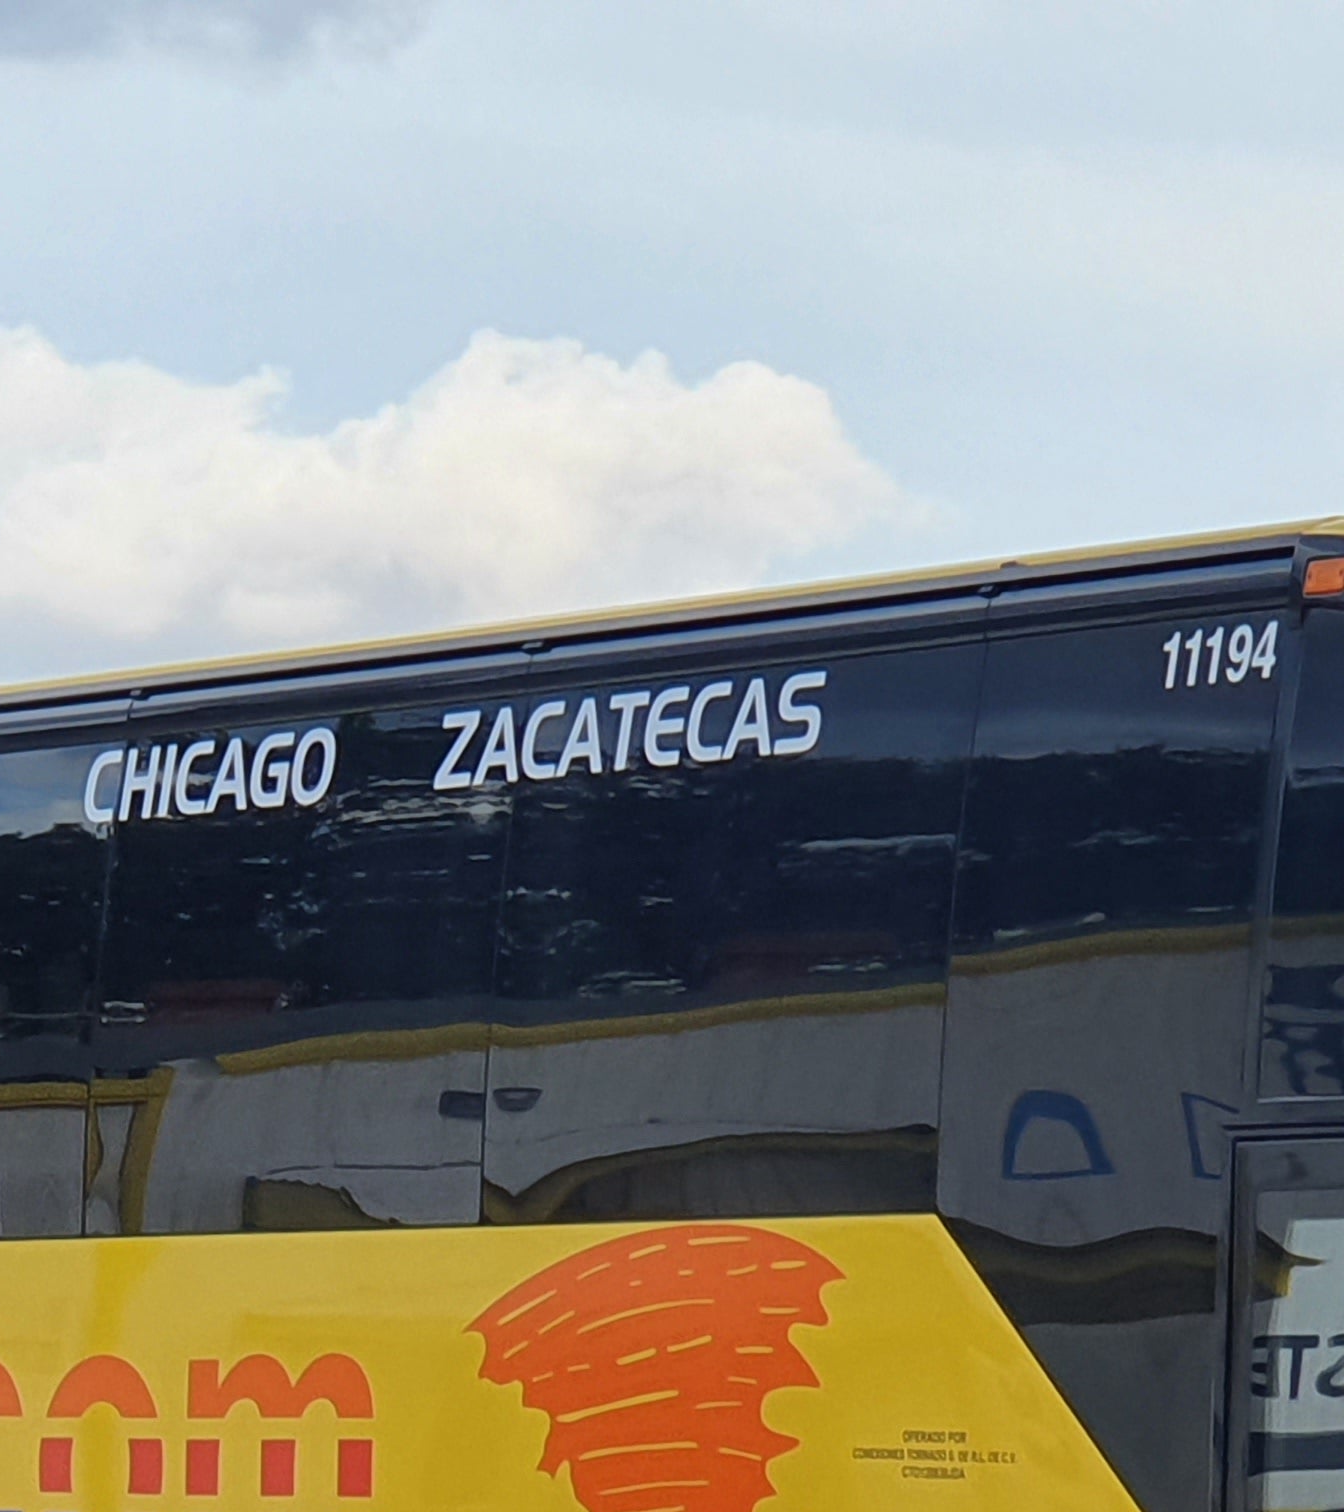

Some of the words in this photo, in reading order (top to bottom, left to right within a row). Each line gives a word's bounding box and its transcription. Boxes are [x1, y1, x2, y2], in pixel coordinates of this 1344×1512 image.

[1162, 620, 1279, 690] 11194
[83, 728, 337, 825] CHICAGO
[433, 671, 828, 791] ZACATECAS
